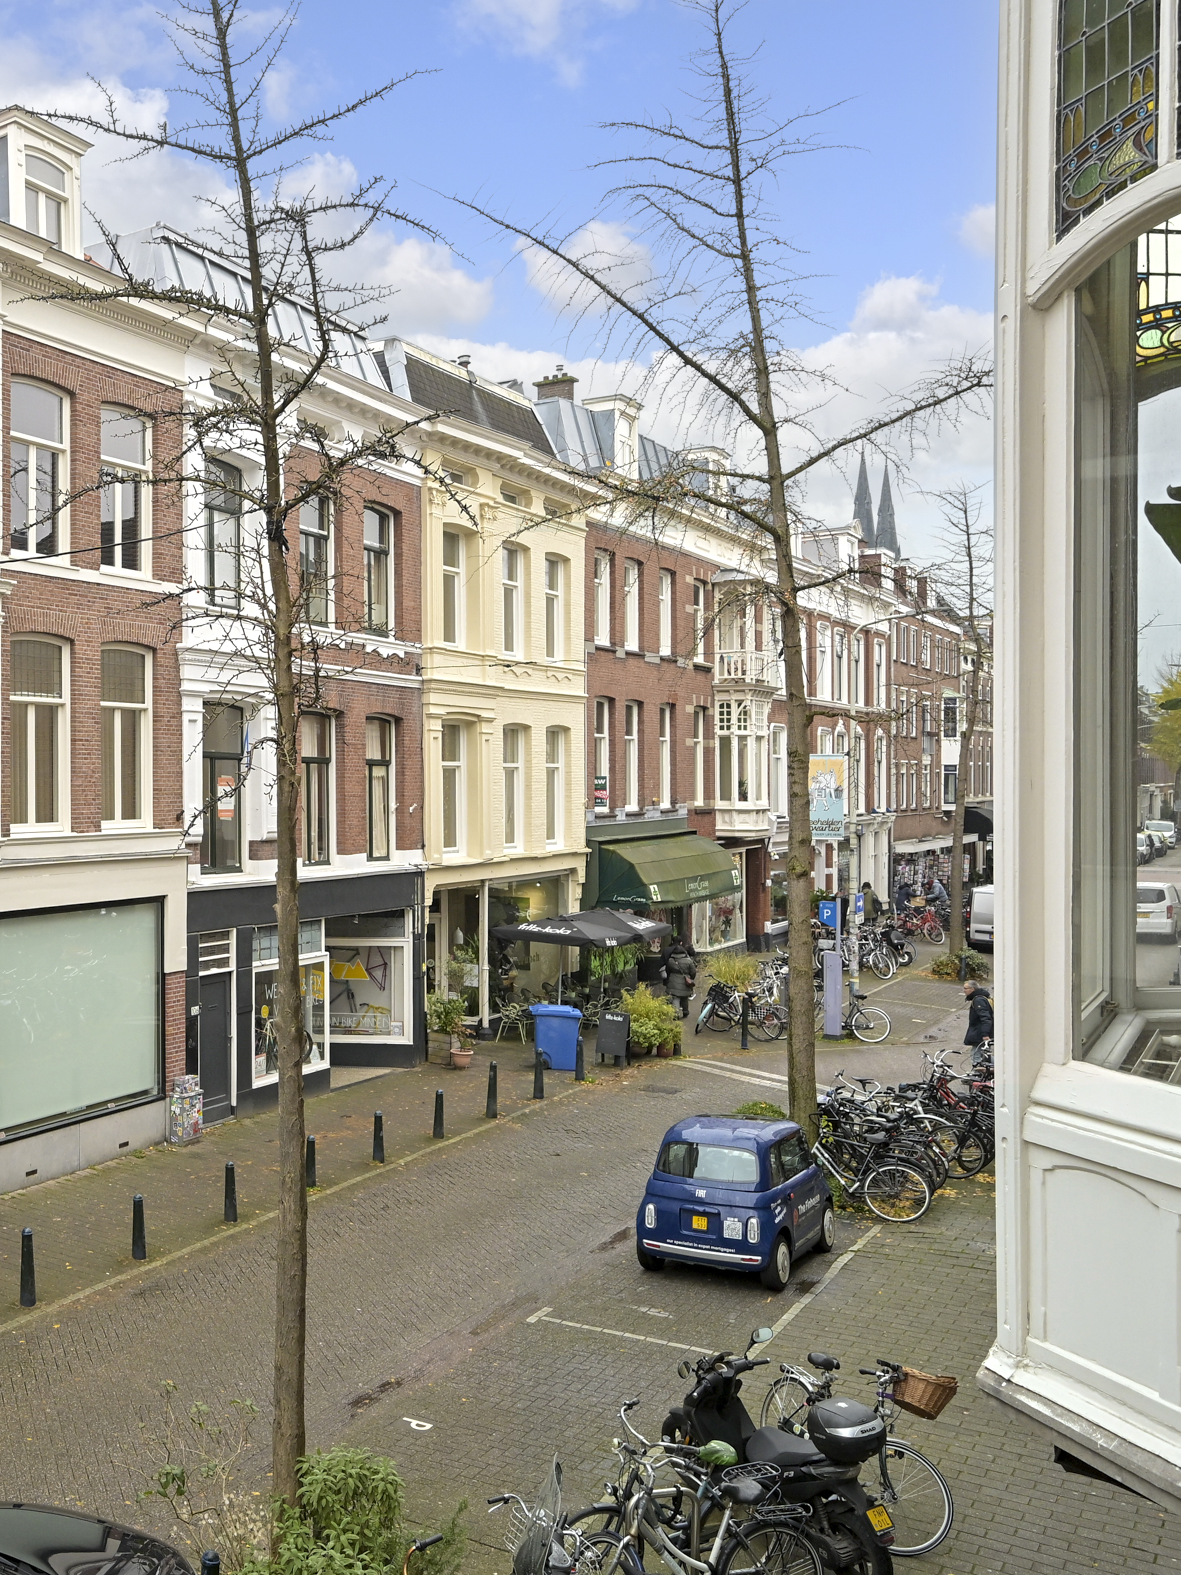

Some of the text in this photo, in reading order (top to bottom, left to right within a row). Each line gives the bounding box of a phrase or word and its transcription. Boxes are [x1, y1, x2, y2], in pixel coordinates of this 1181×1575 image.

[823, 908, 832, 920] P
[517, 923, 572, 935] fritz-kola
[309, 976, 322, 991] FIX
[695, 1189, 707, 1198] FIAT
[798, 1203, 806, 1215] The
[860, 1426, 877, 1435] SHAD
[783, 1470, 795, 1479] F3
[872, 1507, 886, 1519] FNH
